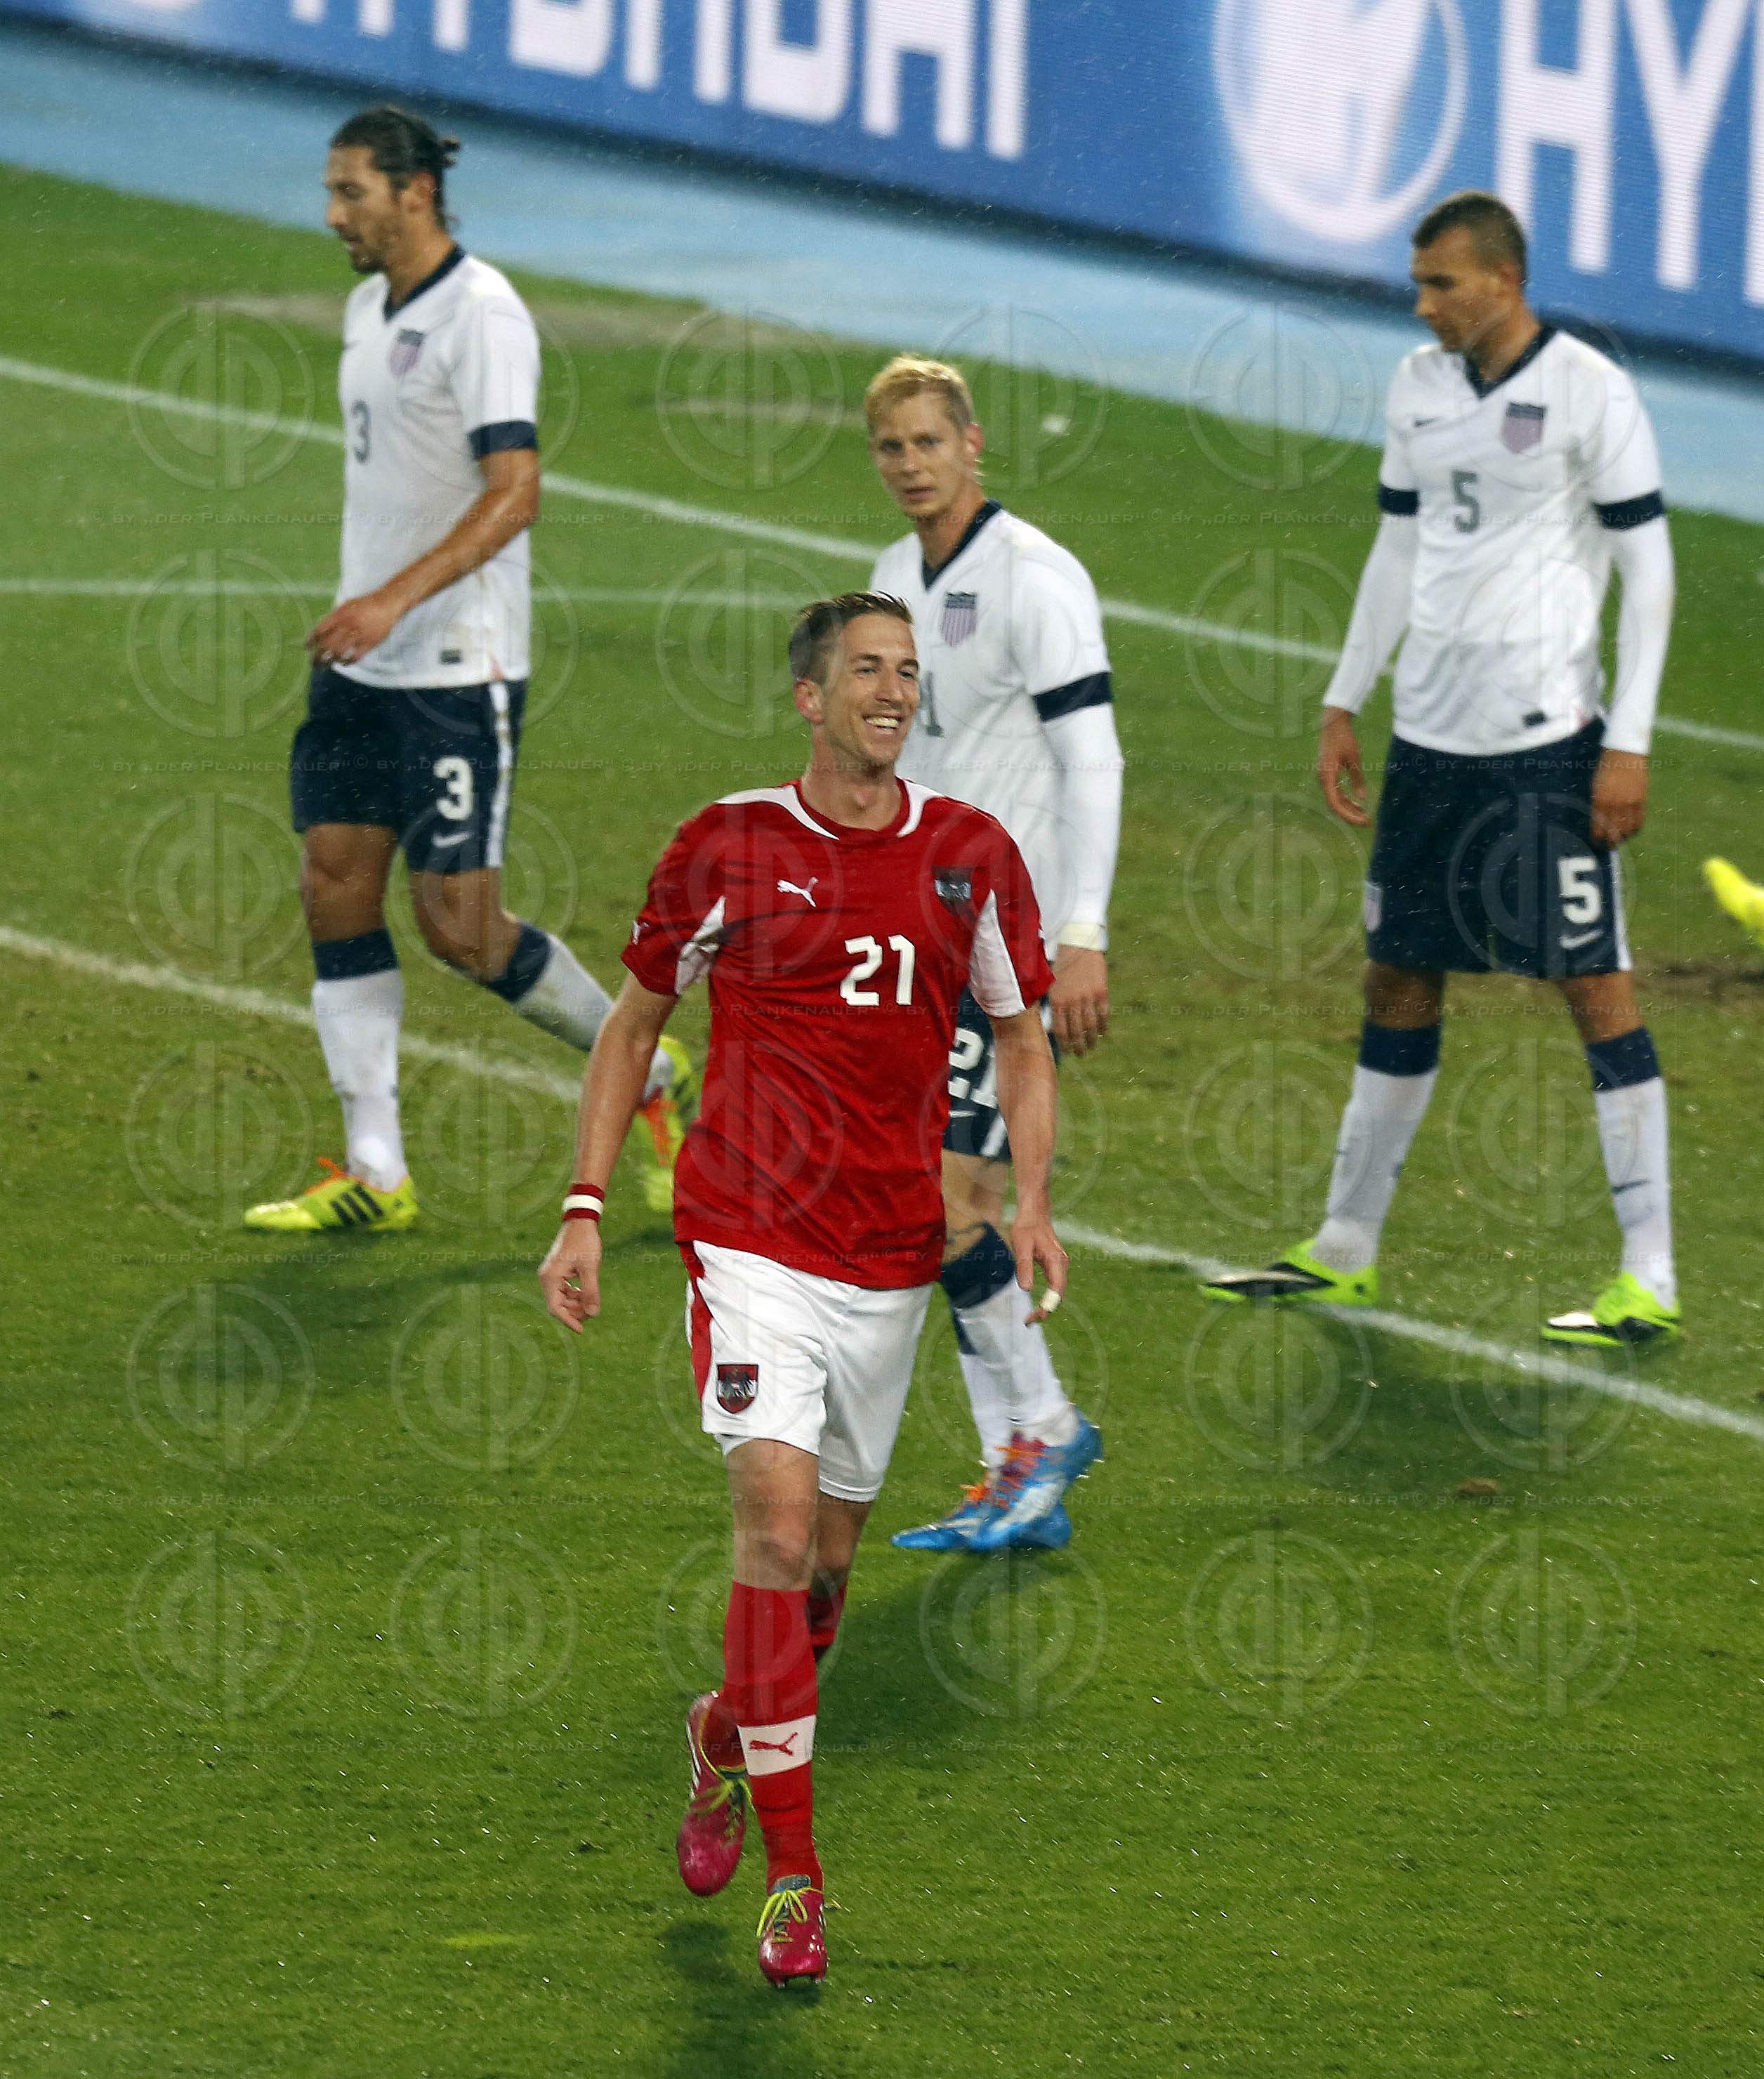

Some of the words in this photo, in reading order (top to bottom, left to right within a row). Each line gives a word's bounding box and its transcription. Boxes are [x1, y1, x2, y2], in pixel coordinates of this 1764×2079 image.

[1494, 0, 1764, 308] HY
[352, 400, 371, 464] 3
[1452, 470, 1480, 534] 5
[433, 754, 474, 821] 3
[1557, 855, 1602, 925] 5
[839, 934, 915, 1006] 21
